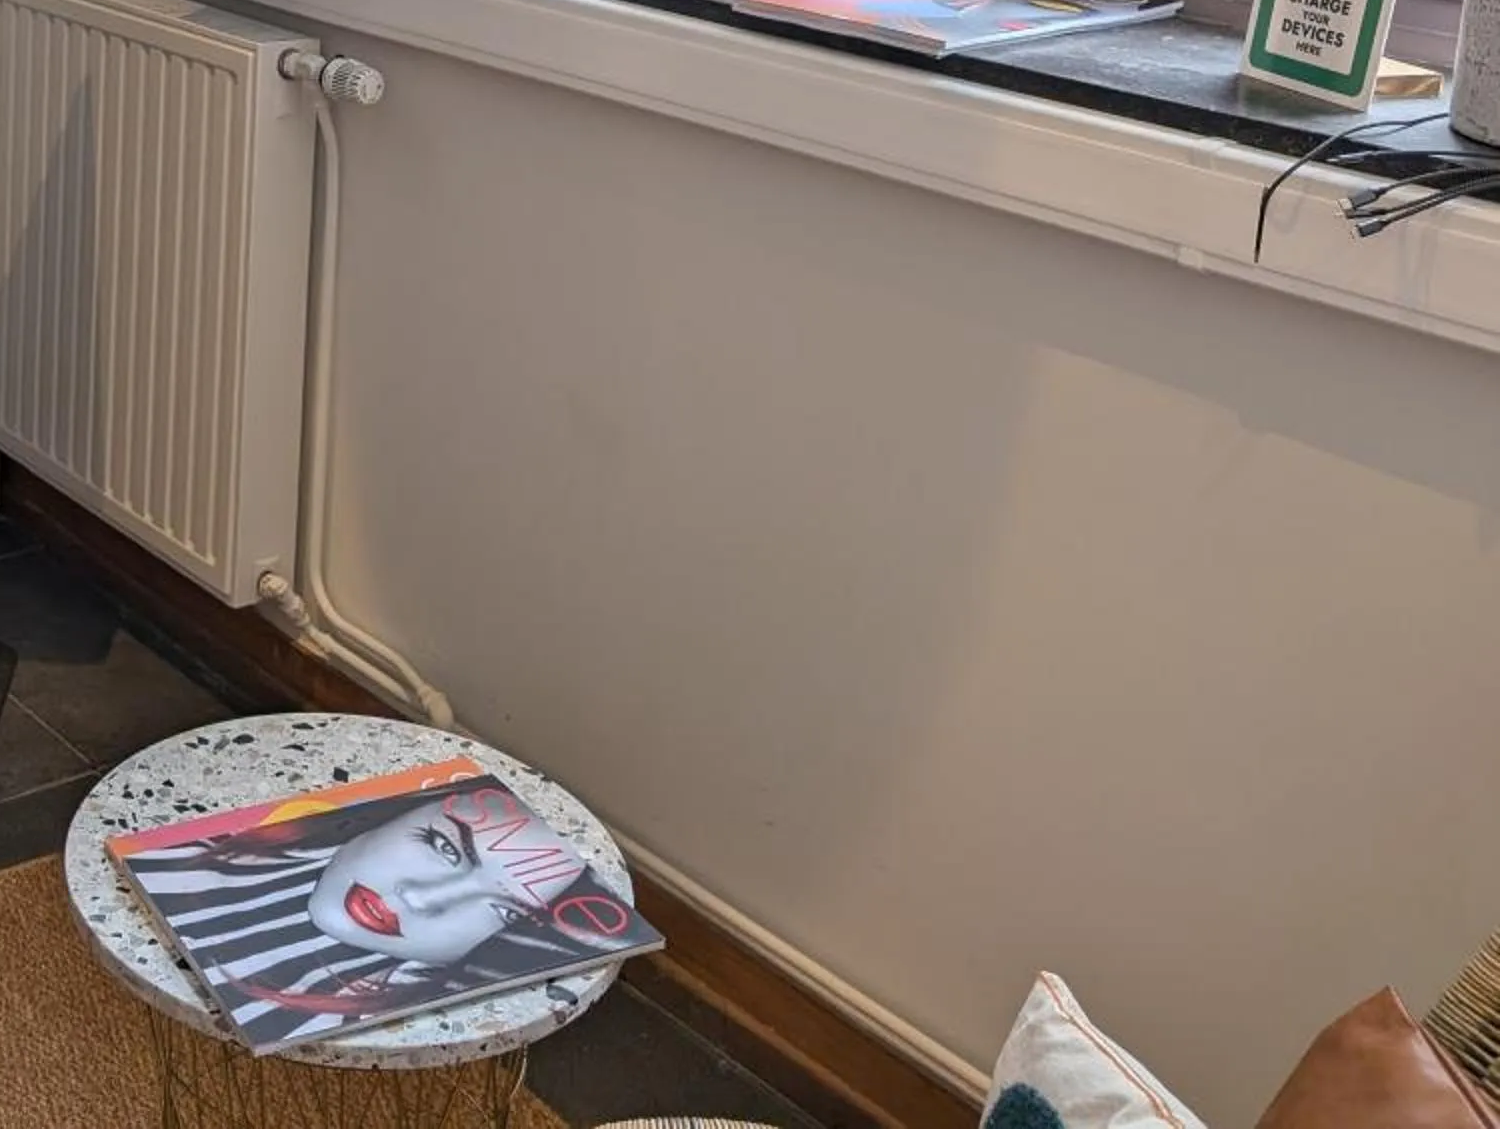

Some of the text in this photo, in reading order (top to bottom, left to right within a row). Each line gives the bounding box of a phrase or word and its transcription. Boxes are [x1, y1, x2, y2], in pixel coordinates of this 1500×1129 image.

[1303, 11, 1330, 25] YOUR
[1282, 19, 1345, 47] DEVICES
[1296, 42, 1321, 56] HERE
